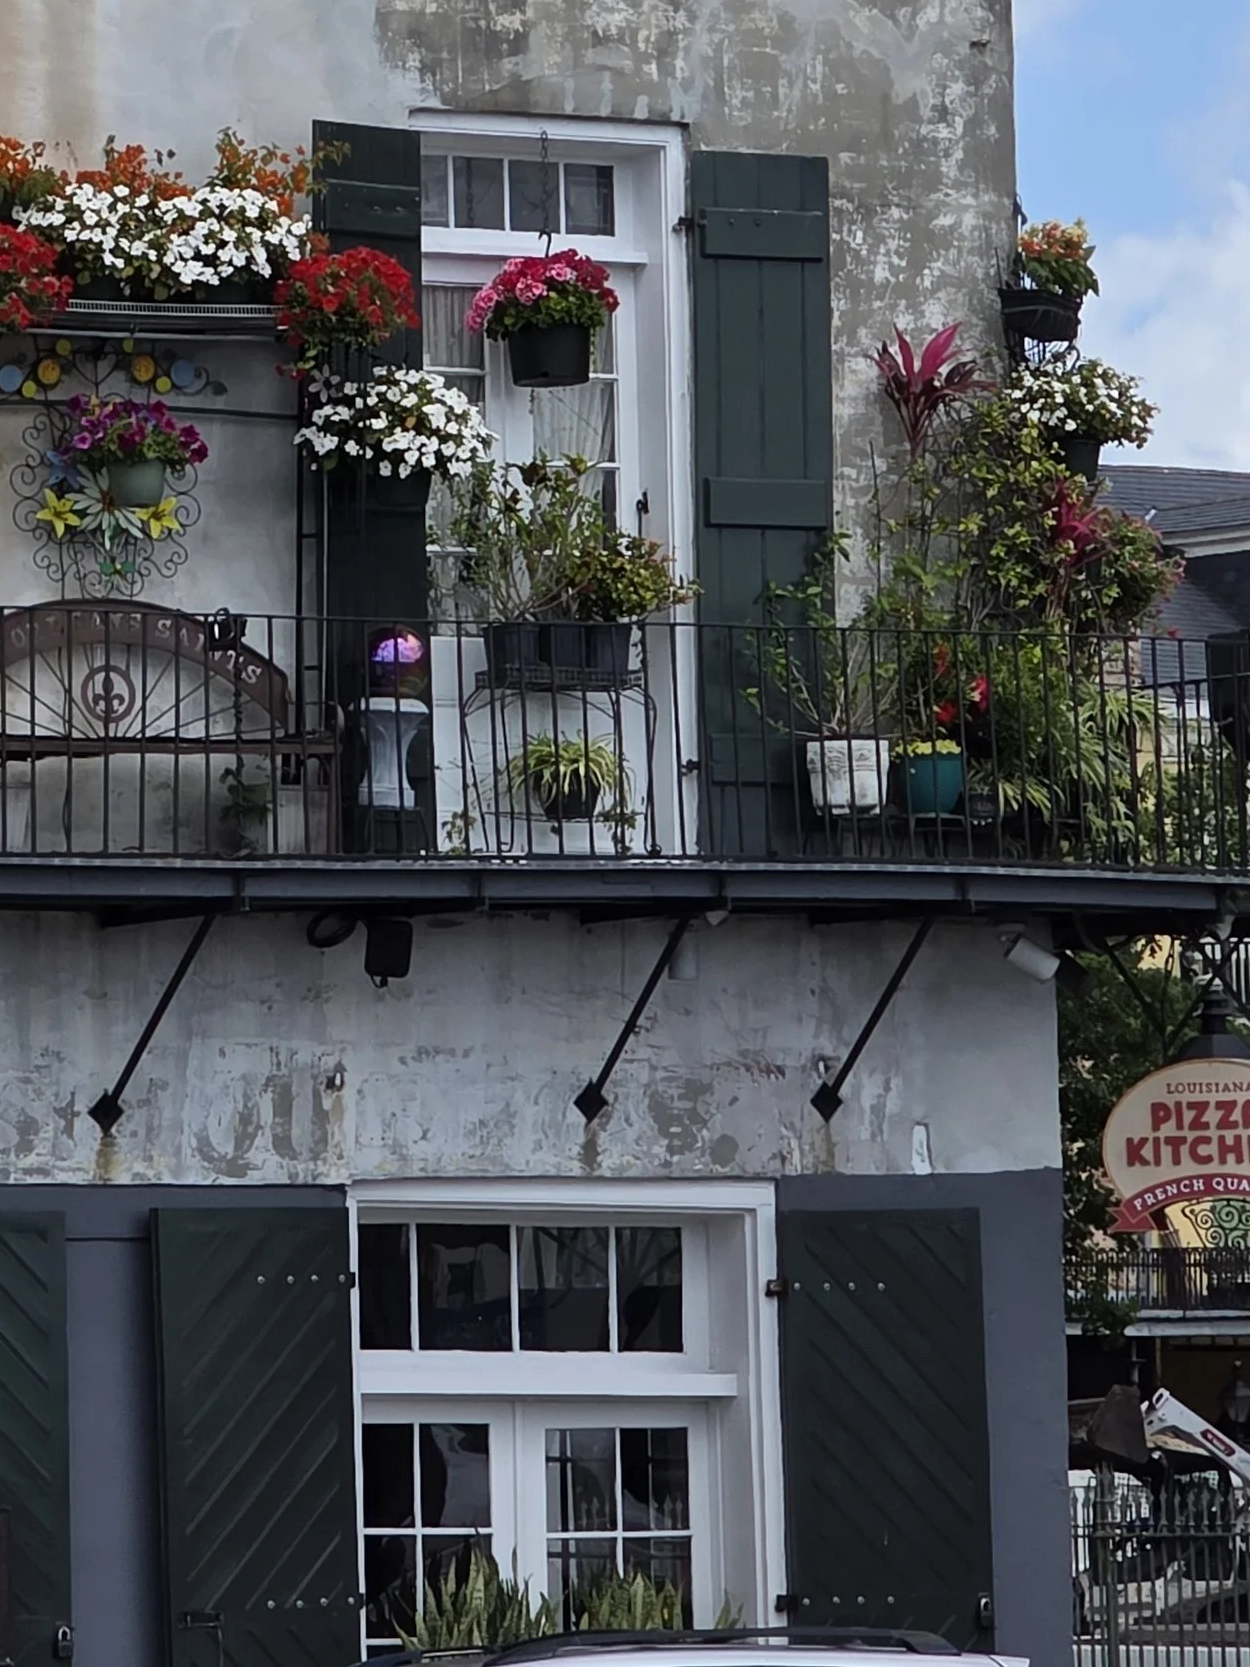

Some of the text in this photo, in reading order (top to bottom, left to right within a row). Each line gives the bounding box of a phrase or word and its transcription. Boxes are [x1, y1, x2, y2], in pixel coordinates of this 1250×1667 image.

[1166, 1081, 1250, 1094] LOUISIANA
[1126, 1135, 1250, 1168] KITCH
[1133, 1177, 1205, 1211] FRENCH
